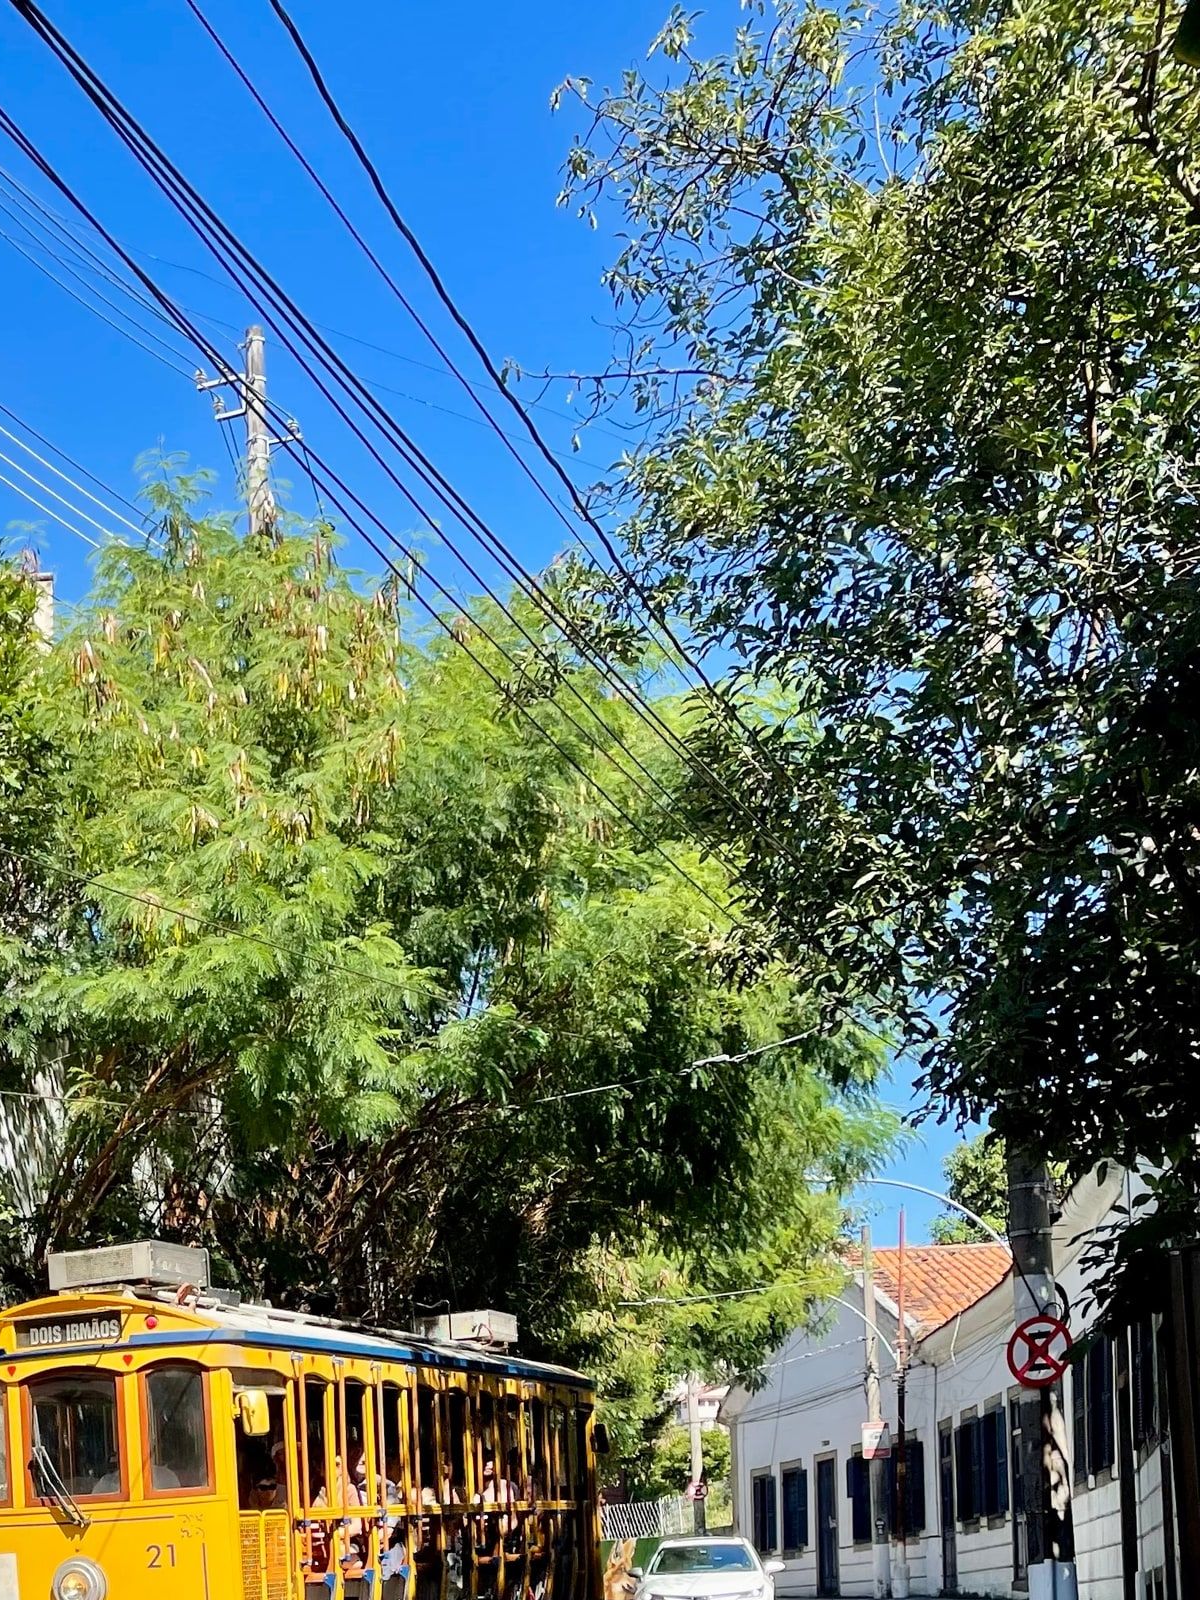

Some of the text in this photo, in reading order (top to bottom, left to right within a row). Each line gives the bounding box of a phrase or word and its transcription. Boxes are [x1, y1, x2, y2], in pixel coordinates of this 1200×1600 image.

[29, 1318, 120, 1345] DOIS IRMÃOS
[145, 1544, 176, 1569] 21
